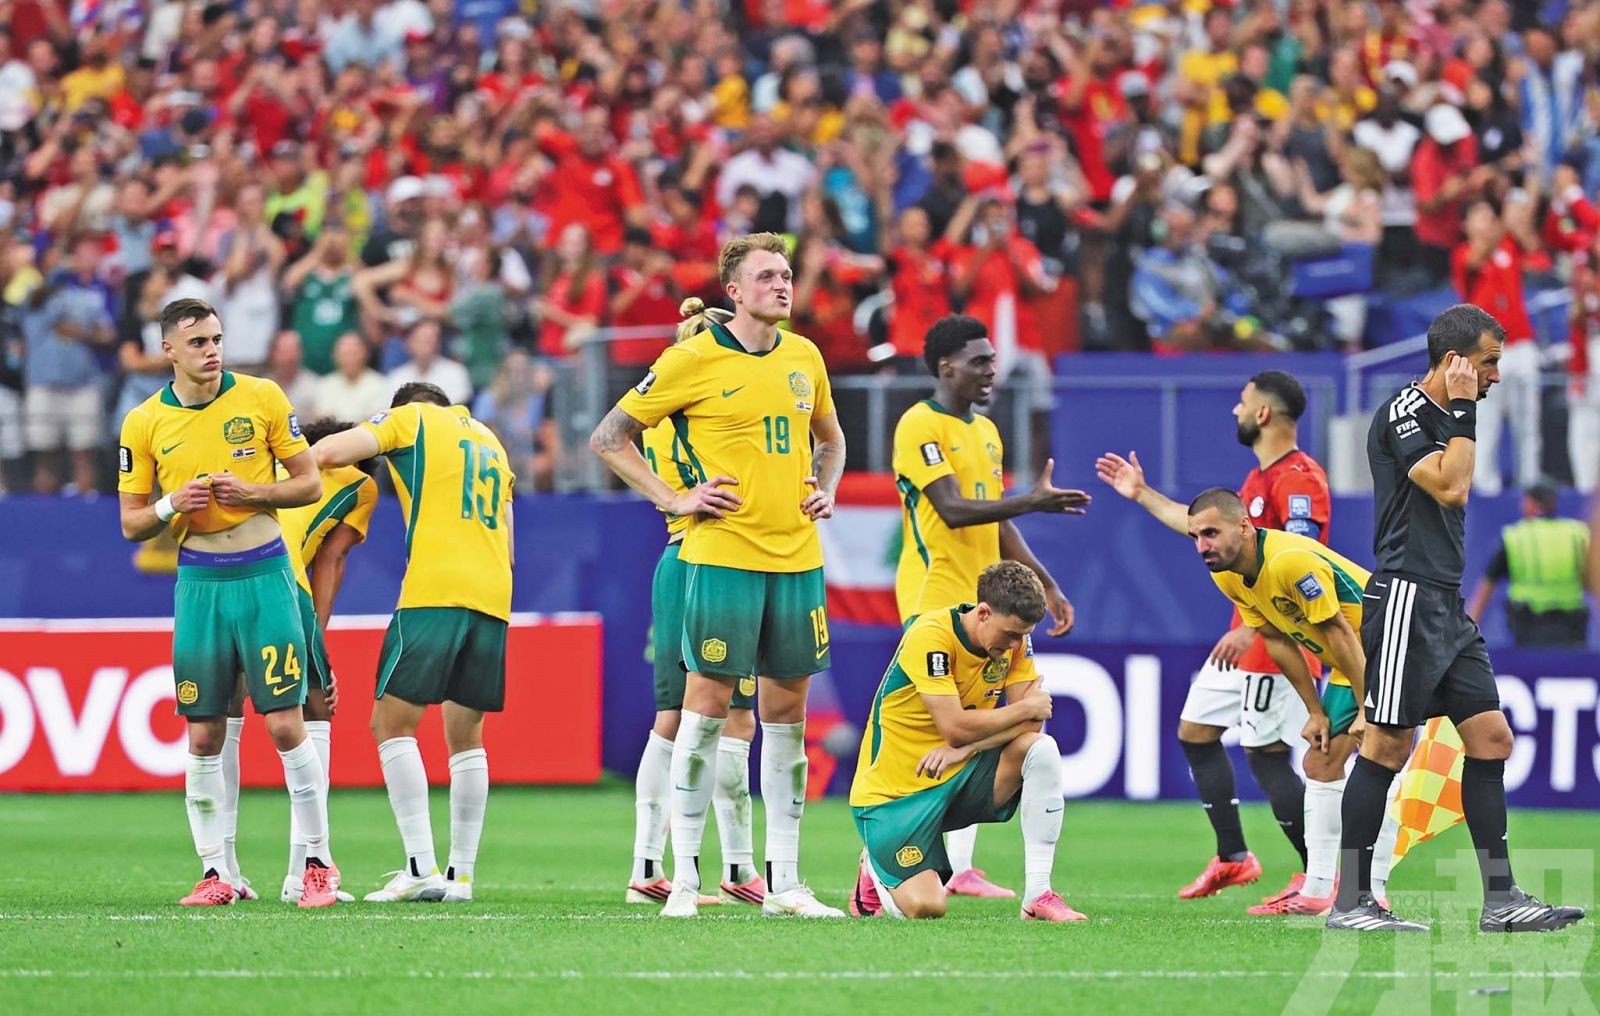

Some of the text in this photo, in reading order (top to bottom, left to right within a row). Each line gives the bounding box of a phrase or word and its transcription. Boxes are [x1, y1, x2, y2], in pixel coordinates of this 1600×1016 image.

[763, 415, 791, 455] 19
[1395, 419, 1419, 434] FIFA
[458, 439, 501, 530] 15
[809, 605, 830, 649] 19
[261, 642, 302, 686] 24
[1243, 674, 1275, 713] 10
